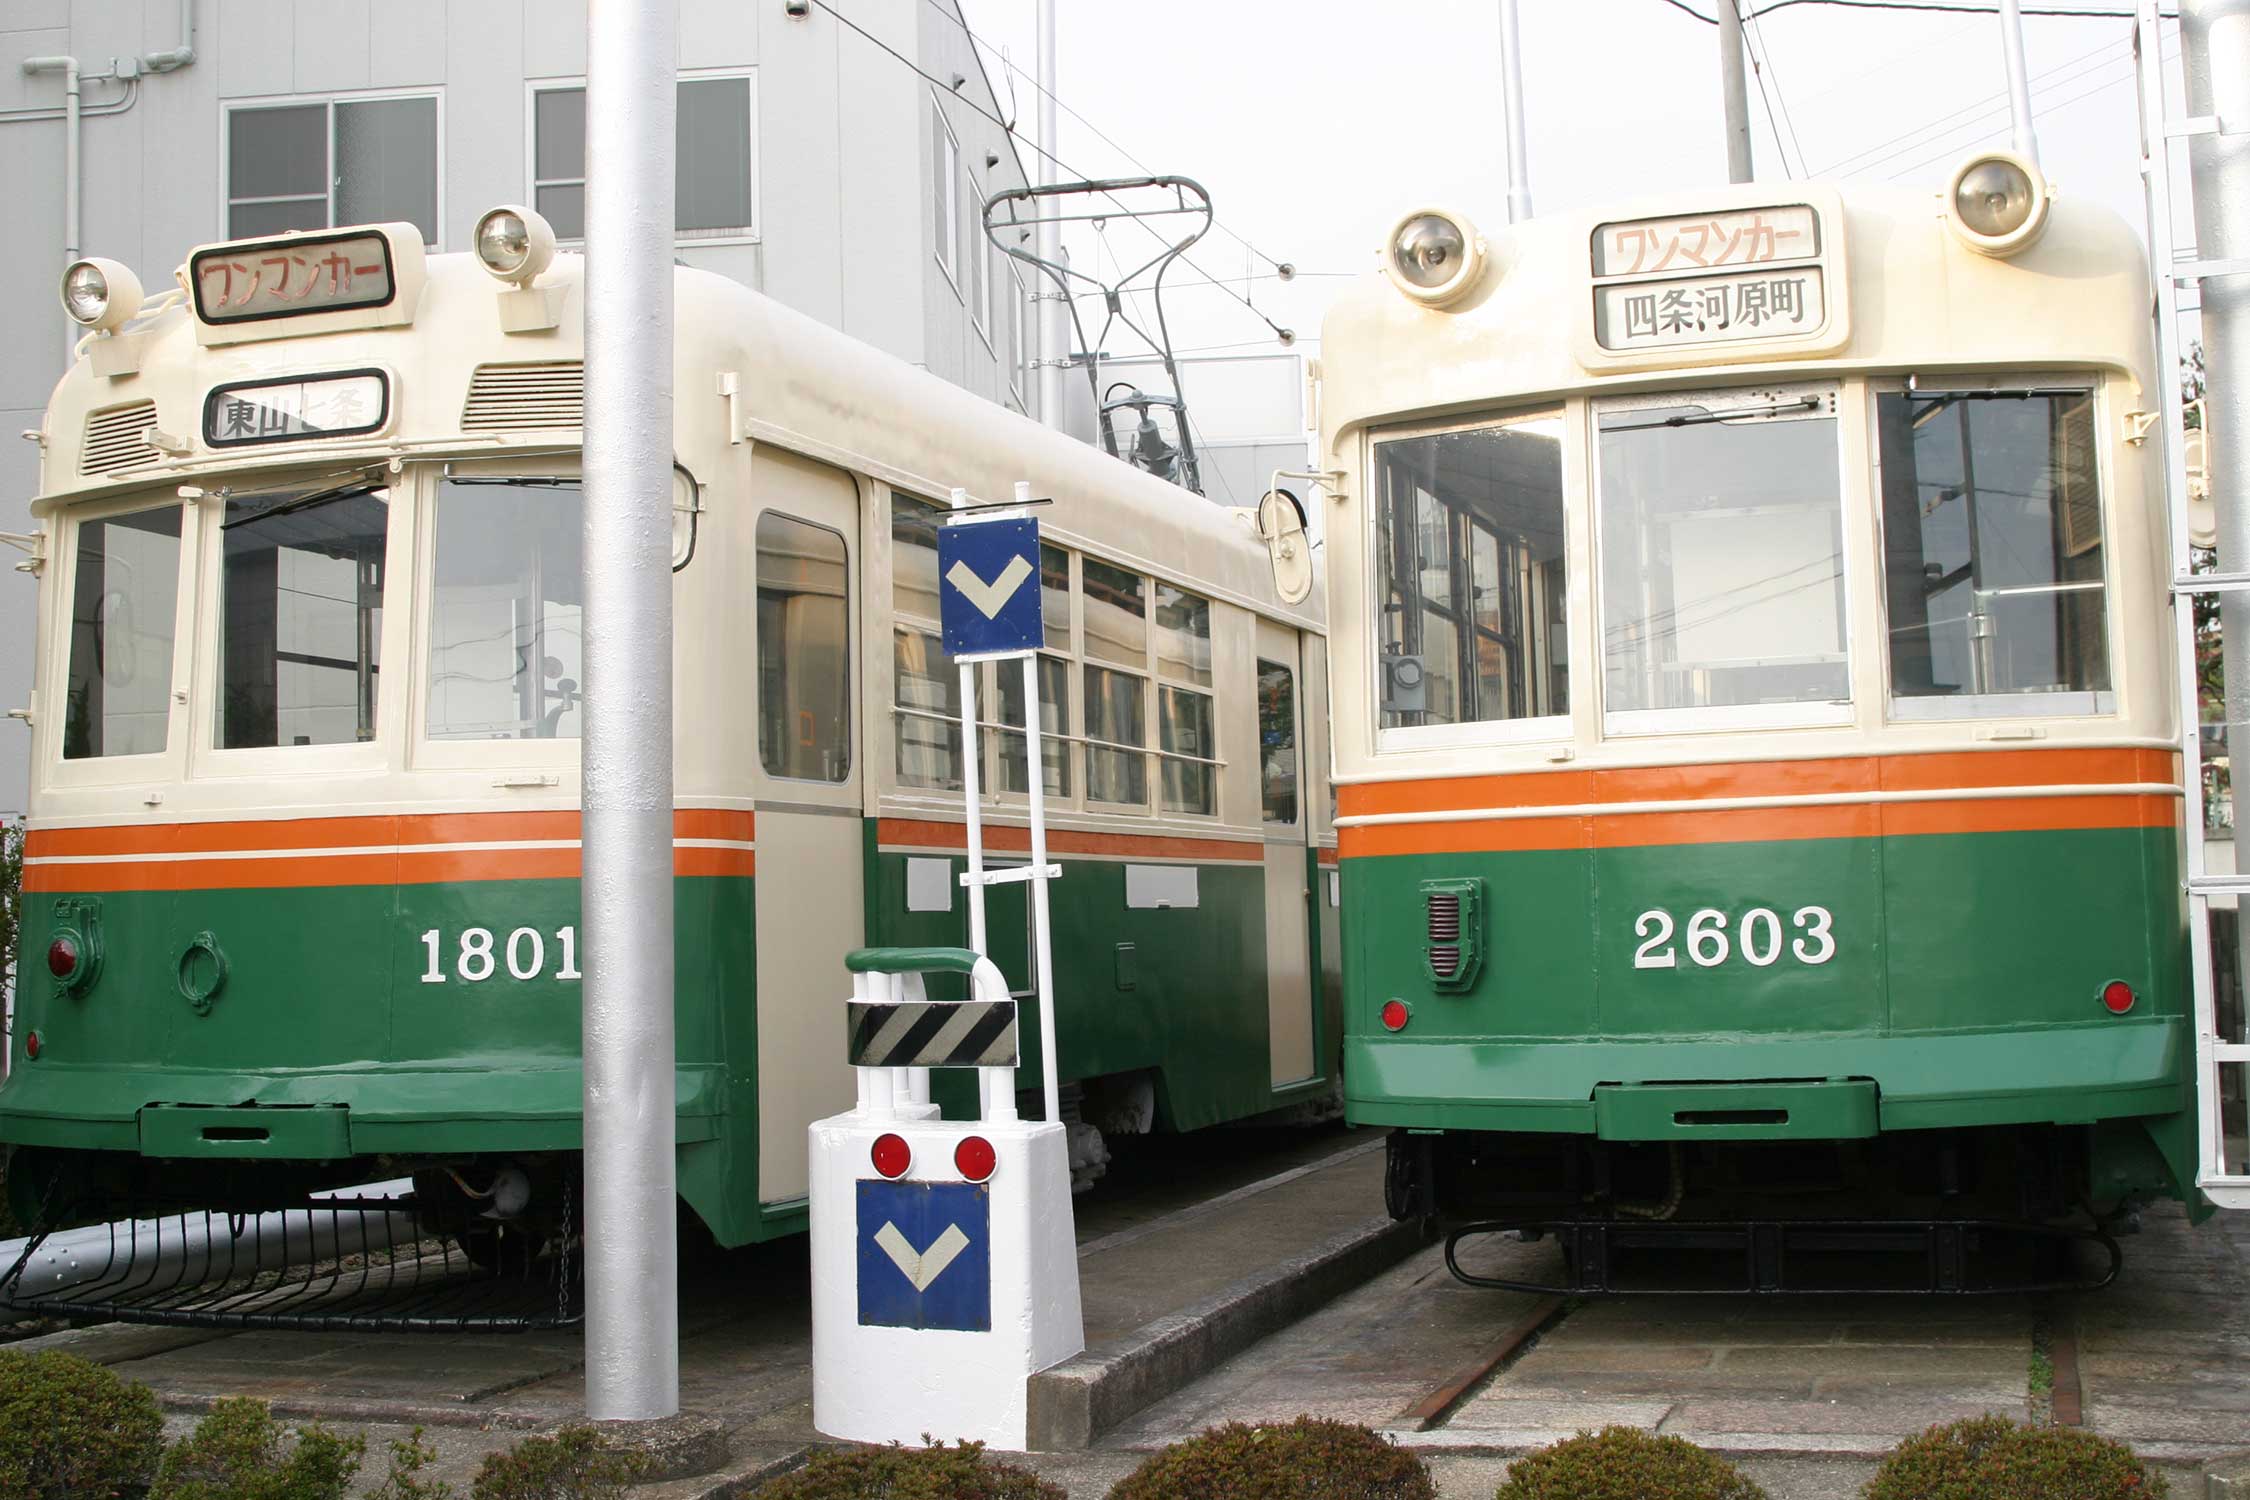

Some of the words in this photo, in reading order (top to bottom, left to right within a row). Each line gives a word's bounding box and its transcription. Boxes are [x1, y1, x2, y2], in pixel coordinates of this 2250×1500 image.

[1616, 215, 1801, 274] ワンマンカー
[200, 251, 383, 308] ワンマンカー
[1624, 278, 1806, 339] 四条河原町
[421, 926, 582, 983] 1801
[1634, 906, 1836, 969] 2603
